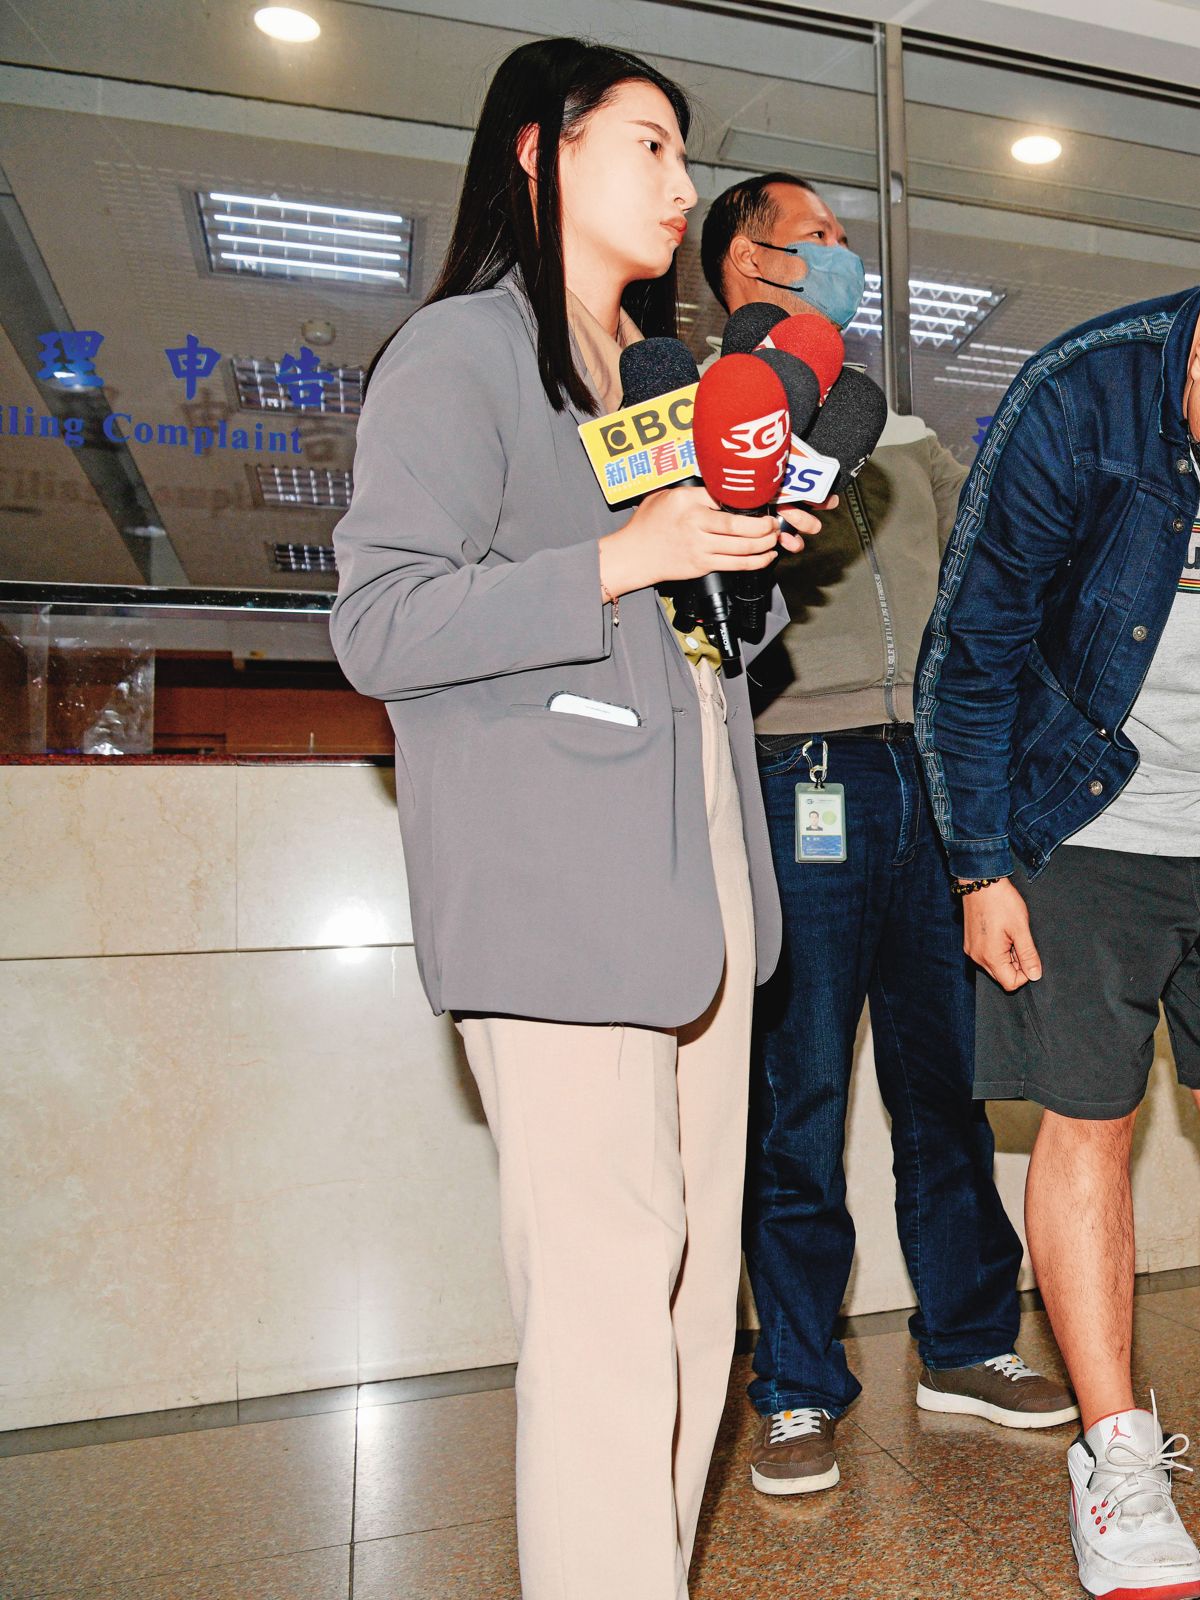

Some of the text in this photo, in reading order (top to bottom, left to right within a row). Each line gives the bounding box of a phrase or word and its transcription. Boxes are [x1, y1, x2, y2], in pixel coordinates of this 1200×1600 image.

[37, 330, 334, 408] 理申告
[103, 412, 303, 455] Complaint
